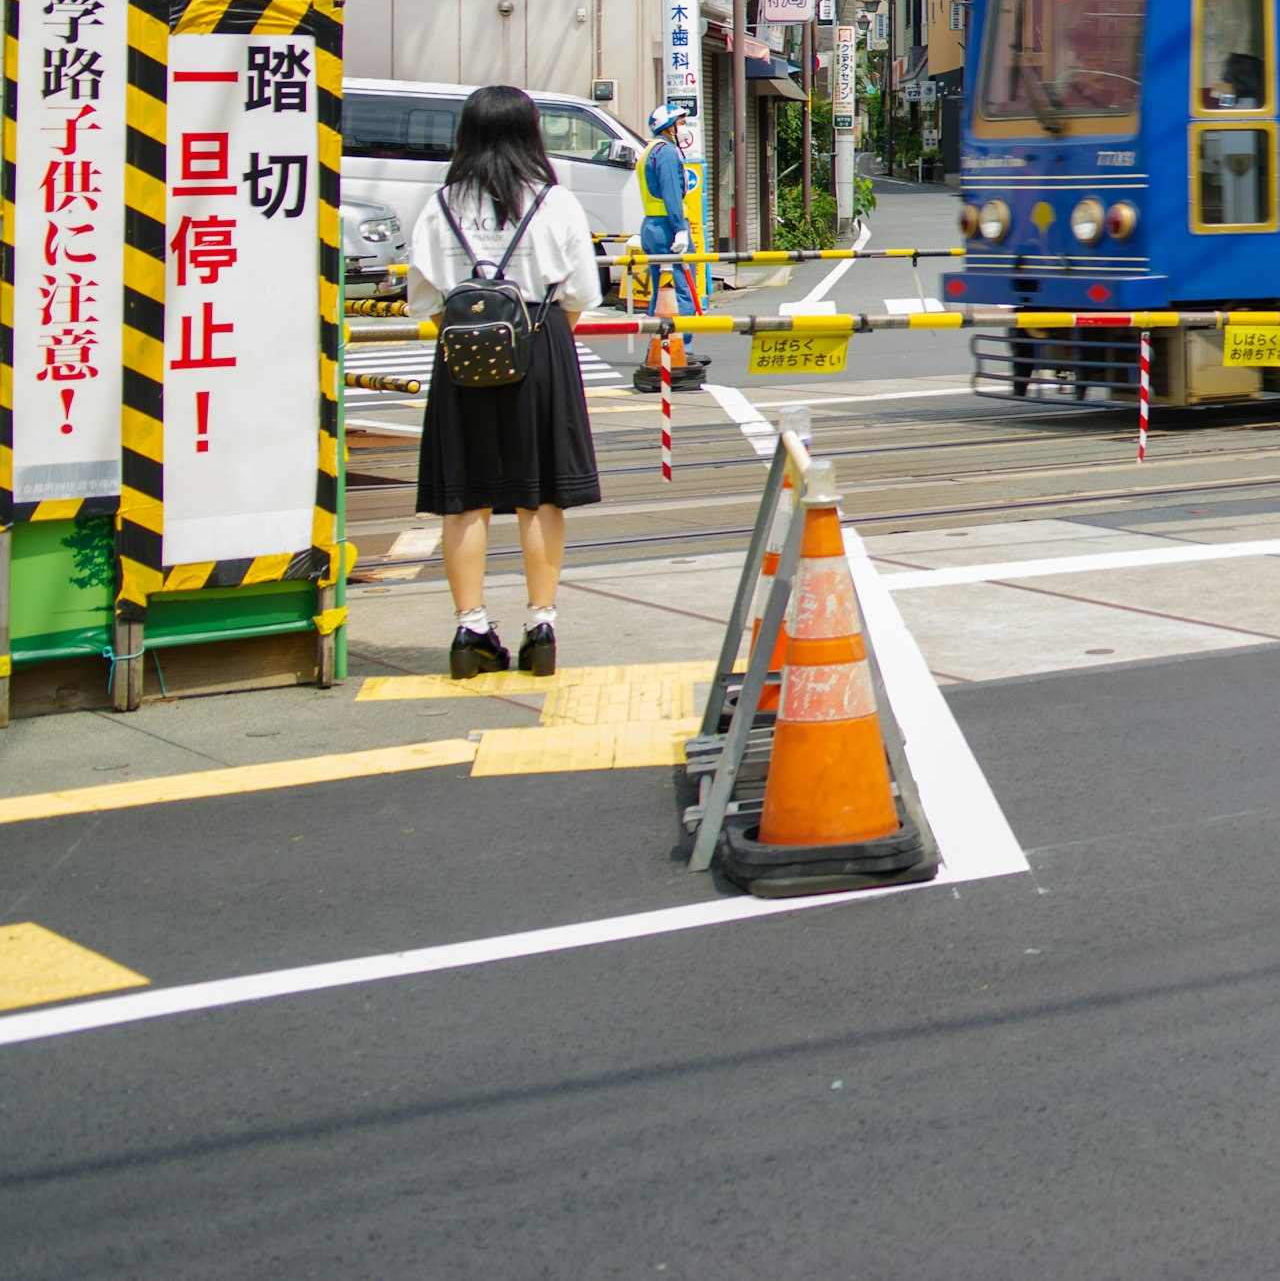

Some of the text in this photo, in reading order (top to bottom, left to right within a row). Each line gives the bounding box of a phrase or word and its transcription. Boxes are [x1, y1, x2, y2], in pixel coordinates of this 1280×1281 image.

[242, 44, 312, 220] 踏切
[761, 338, 815, 353] しばらく
[1233, 333, 1278, 346] しばらく
[757, 353, 841, 367] お待ち下さい
